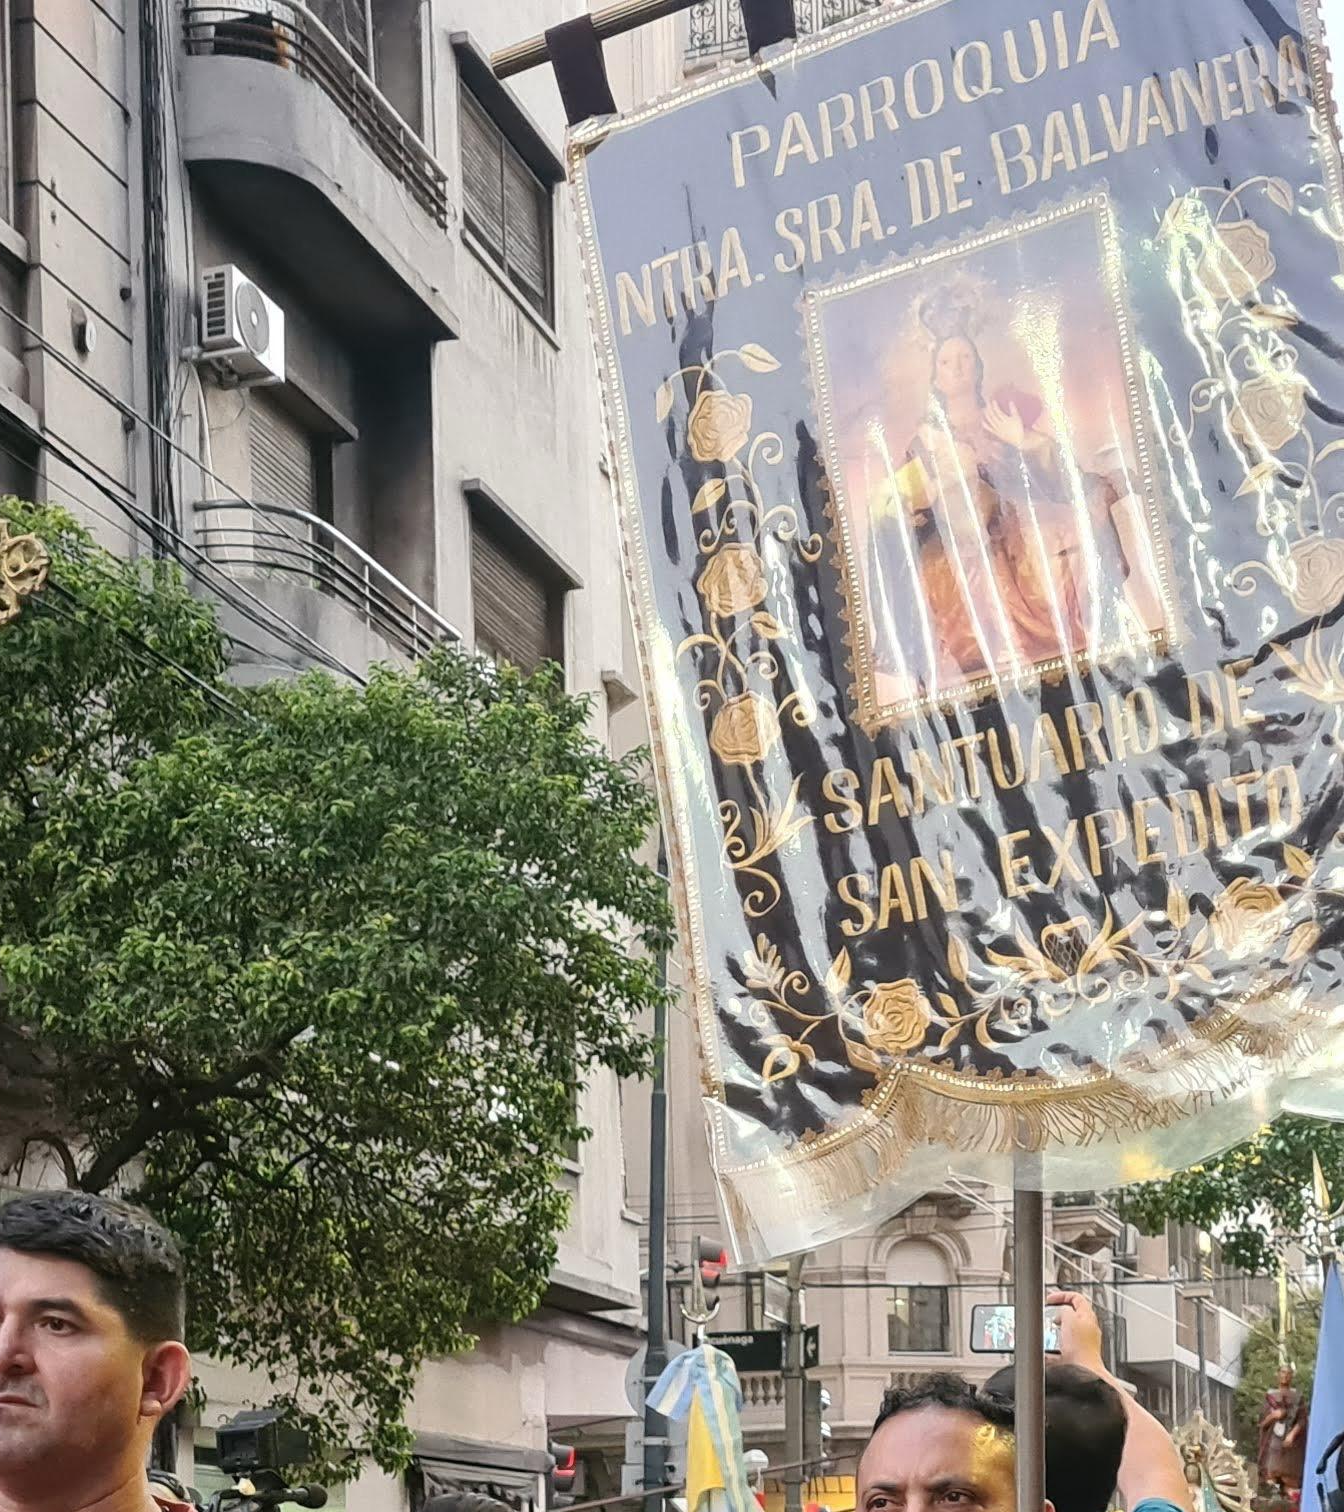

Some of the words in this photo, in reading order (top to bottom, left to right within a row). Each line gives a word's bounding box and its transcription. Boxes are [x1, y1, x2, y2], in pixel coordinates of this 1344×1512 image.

[731, 0, 1120, 189] PARROQUIA
[614, 226, 766, 335] NTRA.
[774, 179, 898, 275] SRA.
[904, 145, 973, 228] DE
[990, 33, 1312, 194] BALVANERA
[821, 685, 1160, 834] SANTUARIO
[1186, 657, 1266, 740] DE
[837, 850, 959, 938] SAN
[999, 764, 1302, 899] EXPEDITO
[704, 1334, 754, 1347] cuénaga
